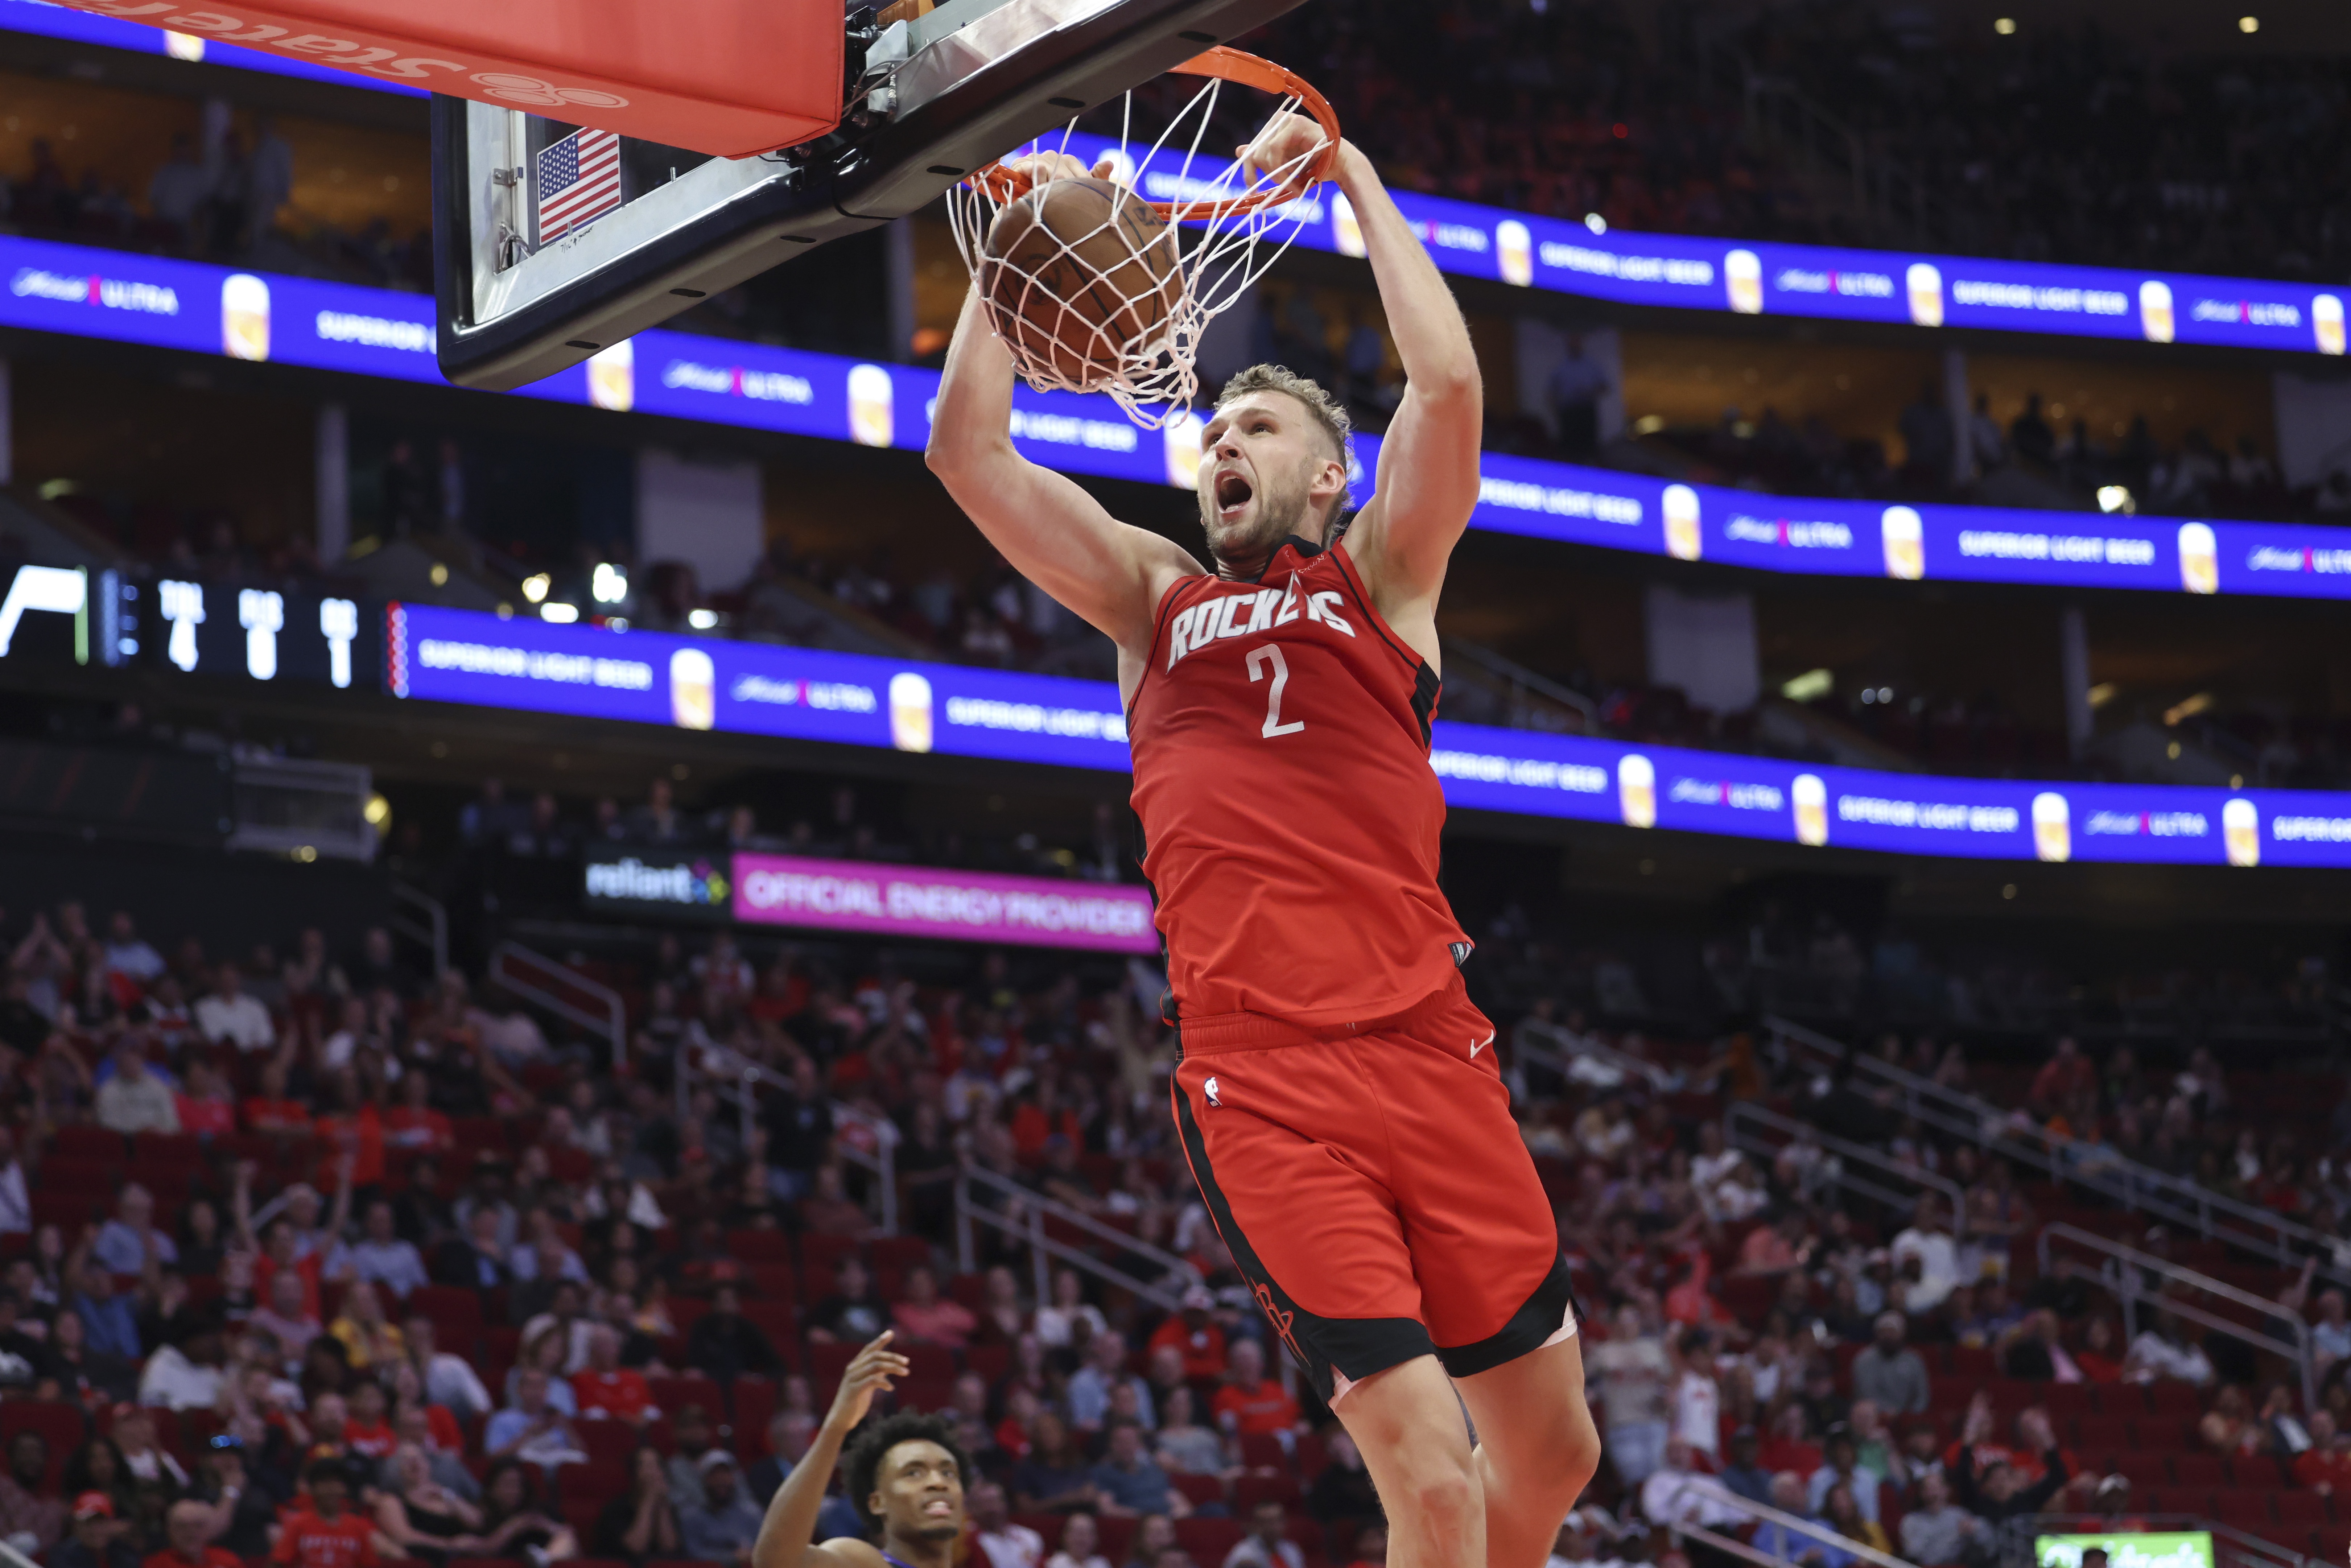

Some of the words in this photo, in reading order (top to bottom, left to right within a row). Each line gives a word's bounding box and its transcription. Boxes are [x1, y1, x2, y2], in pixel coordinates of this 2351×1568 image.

[163, 12, 467, 78] State
[1245, 643, 1304, 739] 2
[586, 857, 696, 904] reliant
[743, 870, 883, 918] OFFICIAL
[886, 881, 1005, 926] ENERGY
[1005, 891, 1150, 937] PROVIDER
